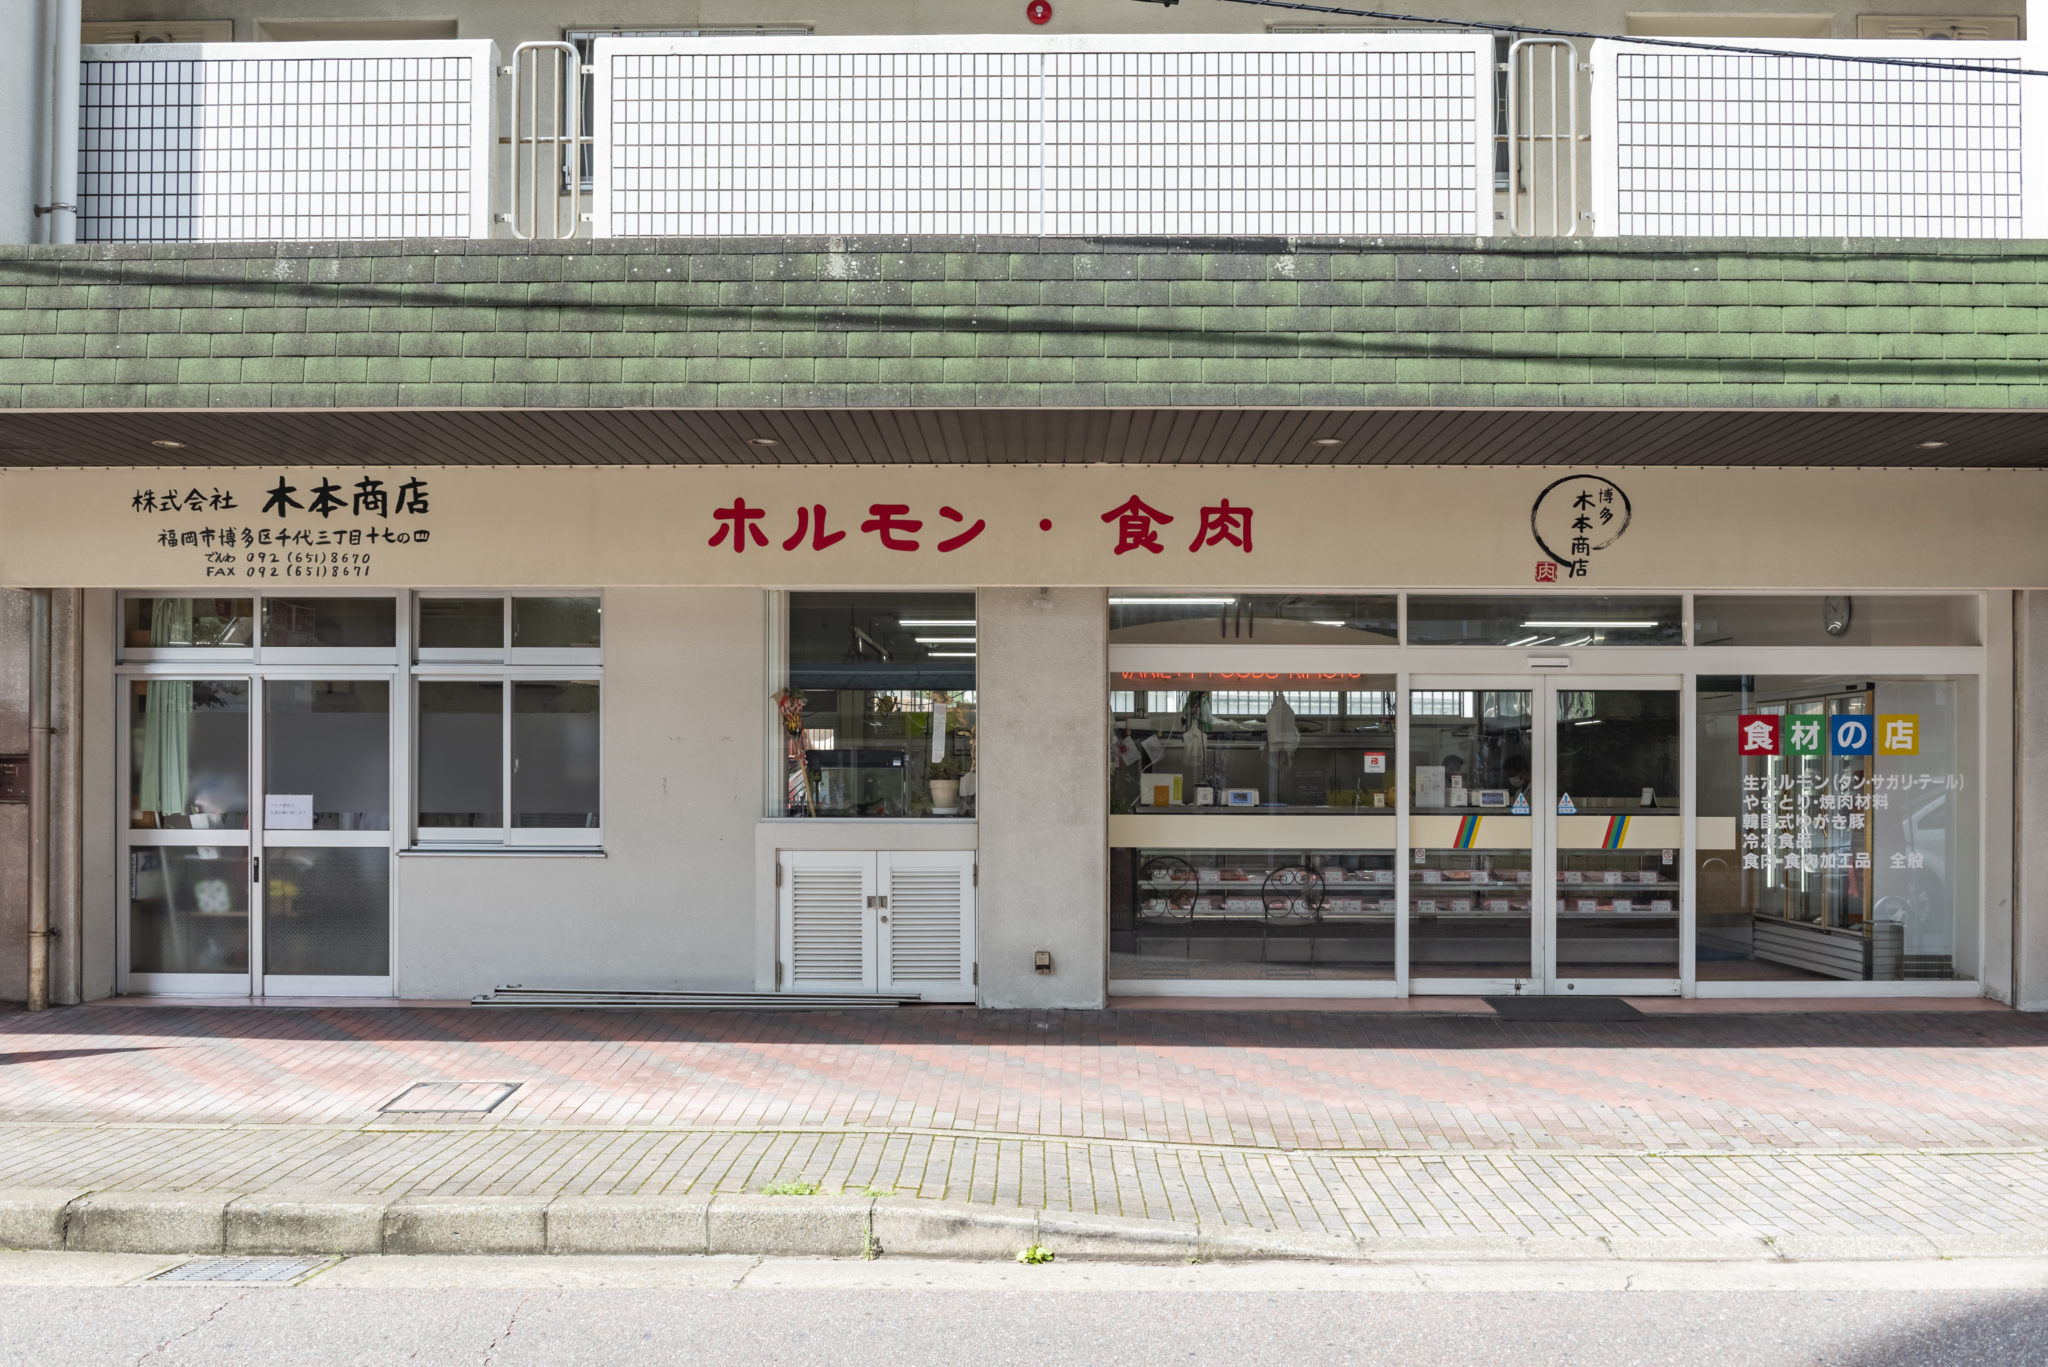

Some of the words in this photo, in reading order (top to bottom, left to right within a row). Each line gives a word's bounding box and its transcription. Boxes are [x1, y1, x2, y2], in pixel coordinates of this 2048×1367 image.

[131, 487, 238, 513] 株式会社
[262, 475, 430, 518] 木本商店
[1598, 487, 1614, 526] 博多
[157, 526, 430, 548] 福岡市博多区千代三丁目十七の四
[1569, 490, 1596, 578] 木本商店
[205, 552, 236, 563] でんわ
[206, 566, 236, 577] FAX
[1536, 562, 1556, 580] 肉
[1743, 720, 1914, 750] 食材の店
[1742, 813, 1866, 830] 韓国式ゆがき豚
[1742, 832, 1812, 850] 冷凍食品
[1889, 852, 1924, 869] 全般
